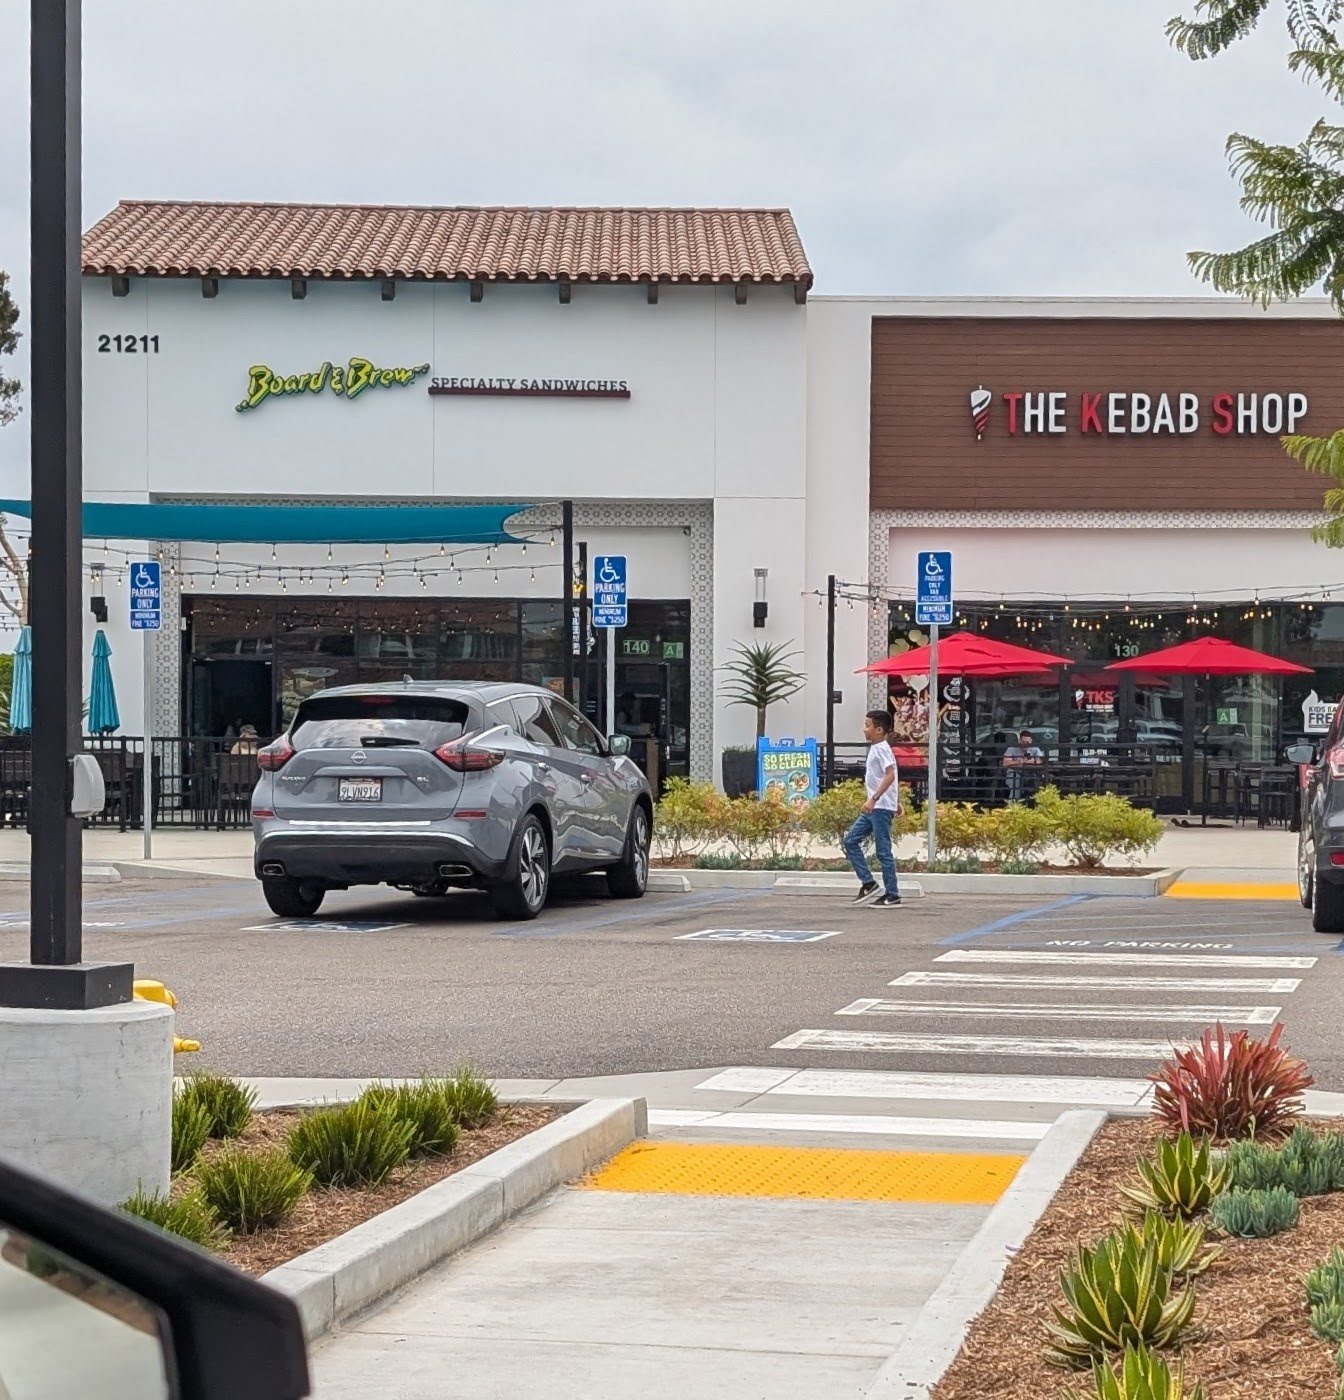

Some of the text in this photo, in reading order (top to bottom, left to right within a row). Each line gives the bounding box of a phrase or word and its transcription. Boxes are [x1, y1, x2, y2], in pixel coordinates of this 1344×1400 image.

[98, 334, 160, 353] 21211
[246, 361, 332, 409] Board
[345, 356, 416, 400] Brew
[431, 377, 516, 390] SPECIALTY
[520, 378, 628, 392] SANDWICHES
[1003, 391, 1308, 435] THE KEBAB SHOP
[132, 588, 159, 597] PARKING
[594, 583, 625, 593] PARKING
[137, 599, 153, 608] ONLY
[601, 594, 618, 604] ONLY
[624, 640, 649, 654] 140
[1114, 645, 1139, 657] 130
[1086, 690, 1114, 703] TKS
[1220, 712, 1228, 721] A
[1308, 713, 1334, 724] FRE
[764, 752, 810, 763] SO FRESH
[764, 760, 811, 770] SO CLEAN
[1103, 940, 1234, 949] PARKING
